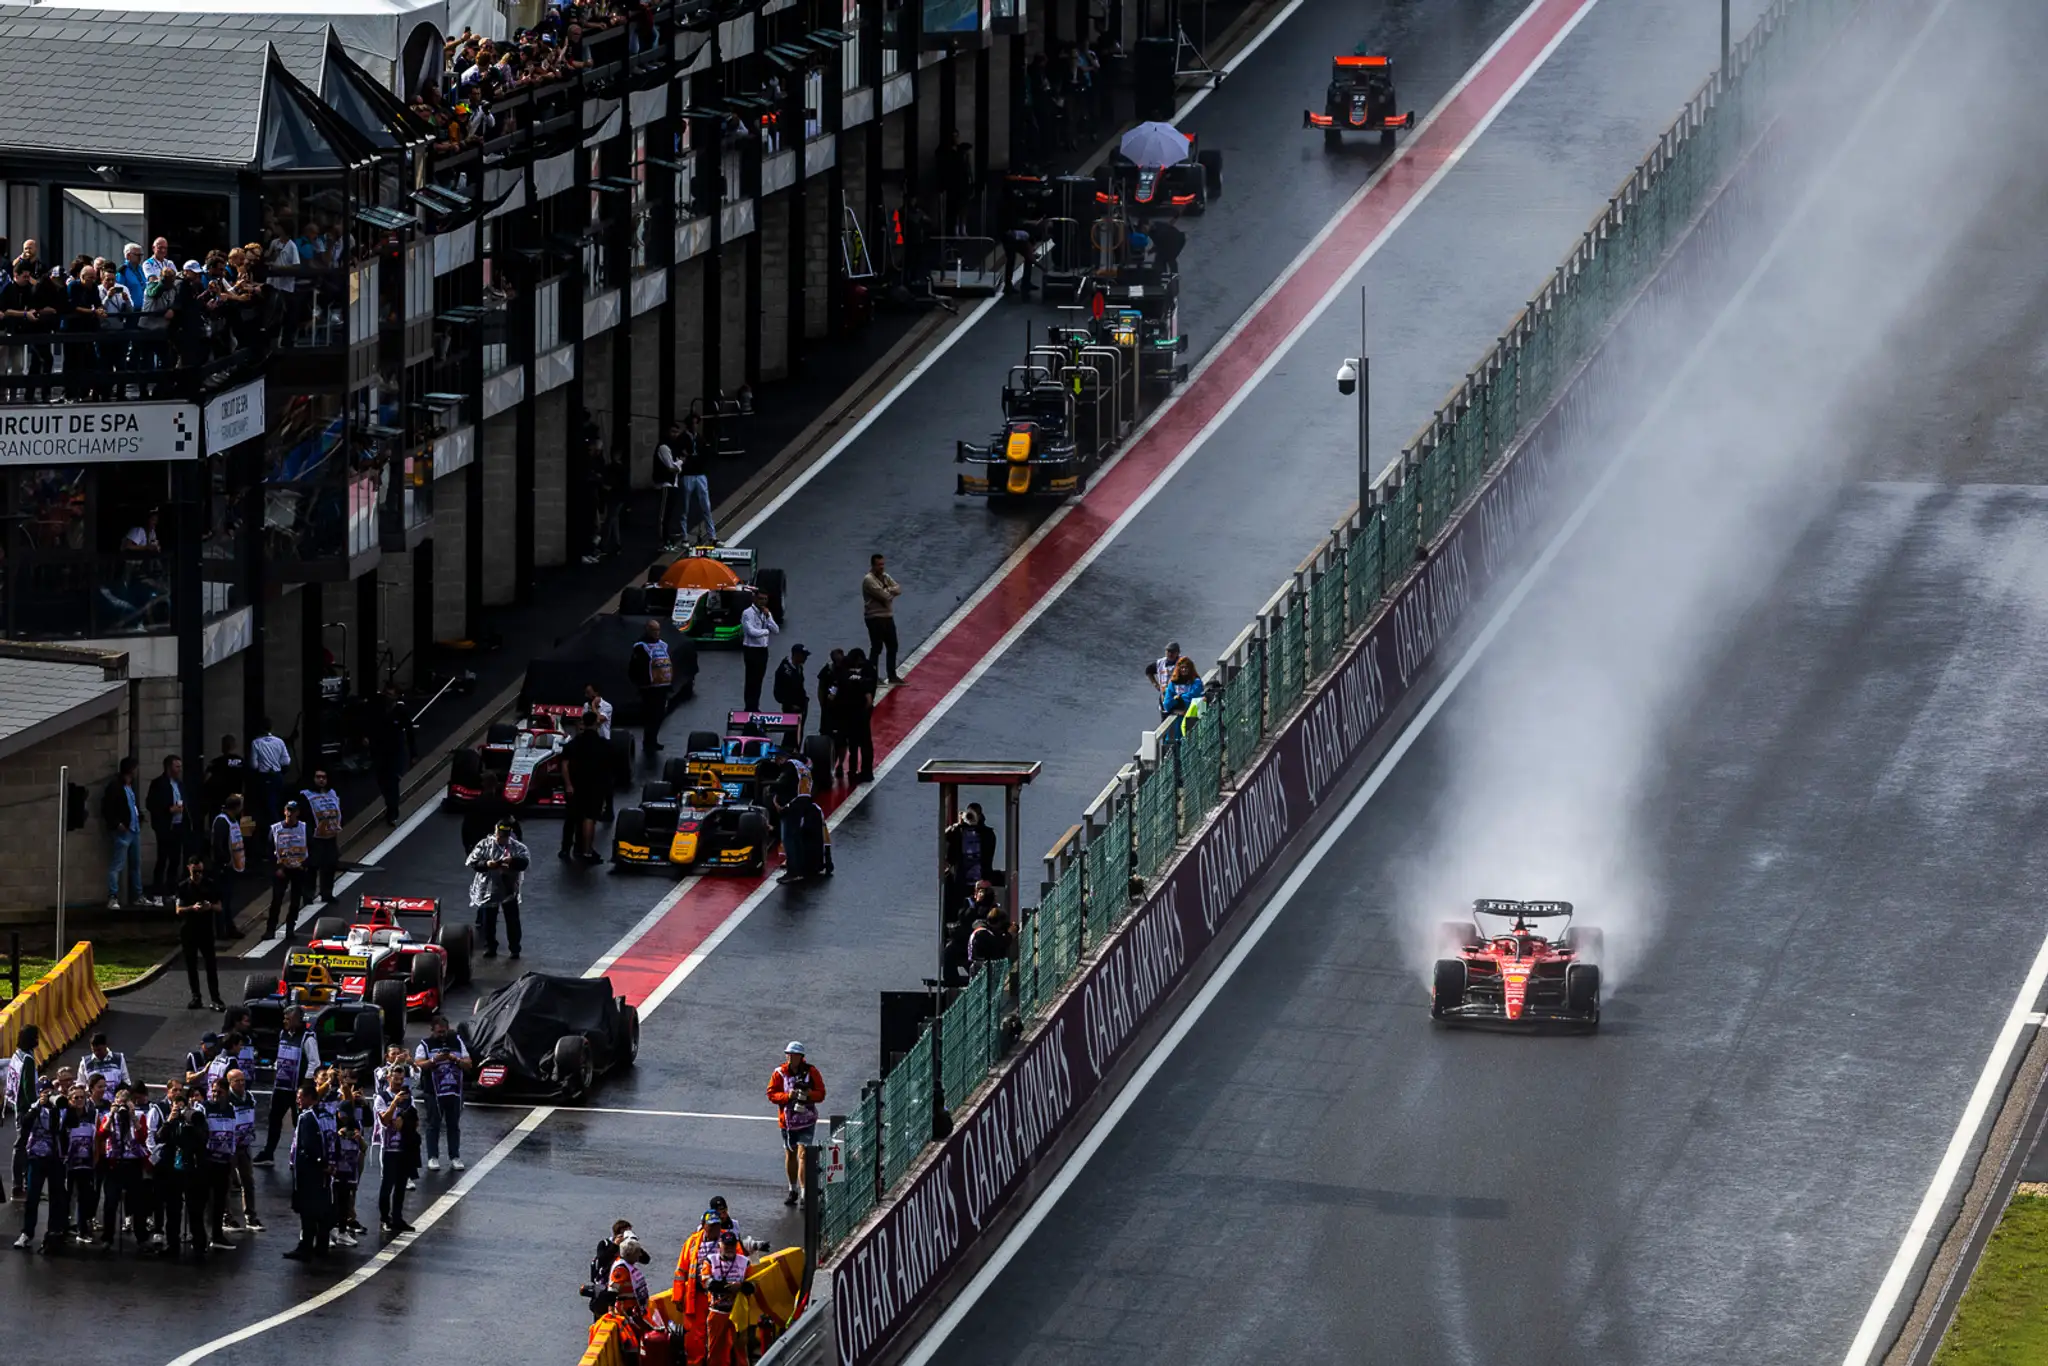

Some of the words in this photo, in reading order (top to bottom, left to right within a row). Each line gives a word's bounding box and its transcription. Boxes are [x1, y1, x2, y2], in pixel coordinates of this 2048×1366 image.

[69, 414, 95, 434] DE
[100, 413, 139, 433] SPA
[1394, 577, 1433, 688] QATAR
[1302, 688, 1344, 807] QATAR
[1340, 636, 1385, 758] AIRWAYS
[511, 774, 523, 784] 8
[1199, 809, 1243, 936] QATAR
[1238, 751, 1288, 881] AIRWAYS
[1486, 901, 1562, 913] Ferrari
[350, 976, 363, 985] 7
[1084, 945, 1133, 1080] QATAR
[1129, 880, 1184, 1021] AIRWAYS
[827, 1164, 844, 1172] FIRE
[963, 1087, 1016, 1232] QATAR
[1013, 1018, 1072, 1167] AIRWAYS
[836, 1228, 895, 1366] QATAR
[895, 1153, 959, 1312] AIRWAYS
